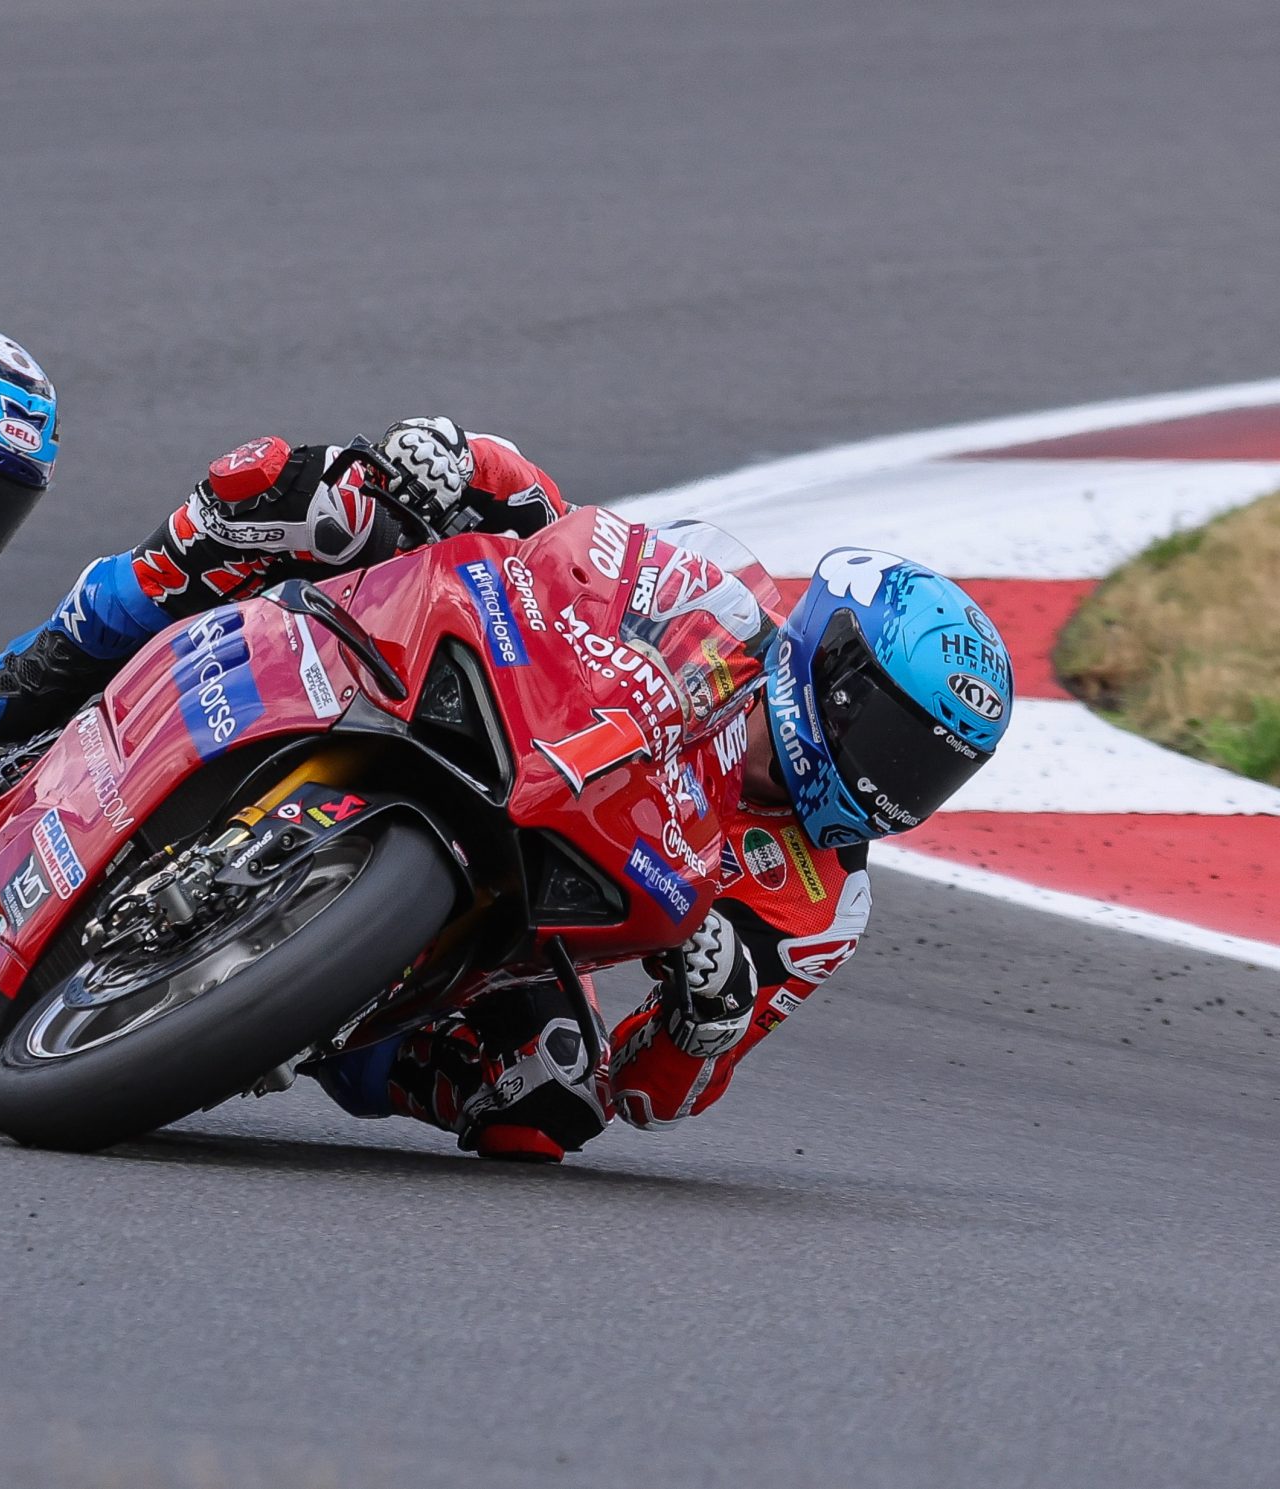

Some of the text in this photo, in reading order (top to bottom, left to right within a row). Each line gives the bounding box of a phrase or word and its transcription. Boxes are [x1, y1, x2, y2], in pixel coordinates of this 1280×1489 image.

[4, 426, 38, 447] BELL
[477, 575, 517, 663] InfraHorse
[631, 566, 660, 615] WRS
[940, 632, 1007, 680] HERR
[944, 654, 1007, 693] COMPOU
[558, 605, 693, 804] MOUNT AIRY
[631, 688, 664, 762] RESORT
[775, 640, 811, 776] OnlyFans
[953, 679, 1001, 718] KYT
[533, 706, 652, 794] 1
[945, 734, 978, 760] OnlyFans
[875, 794, 920, 826] OnlyFans
[33, 824, 71, 898] UNLIMITED
[42, 809, 86, 889] PARTS
[645, 857, 690, 916] InfraHorse
